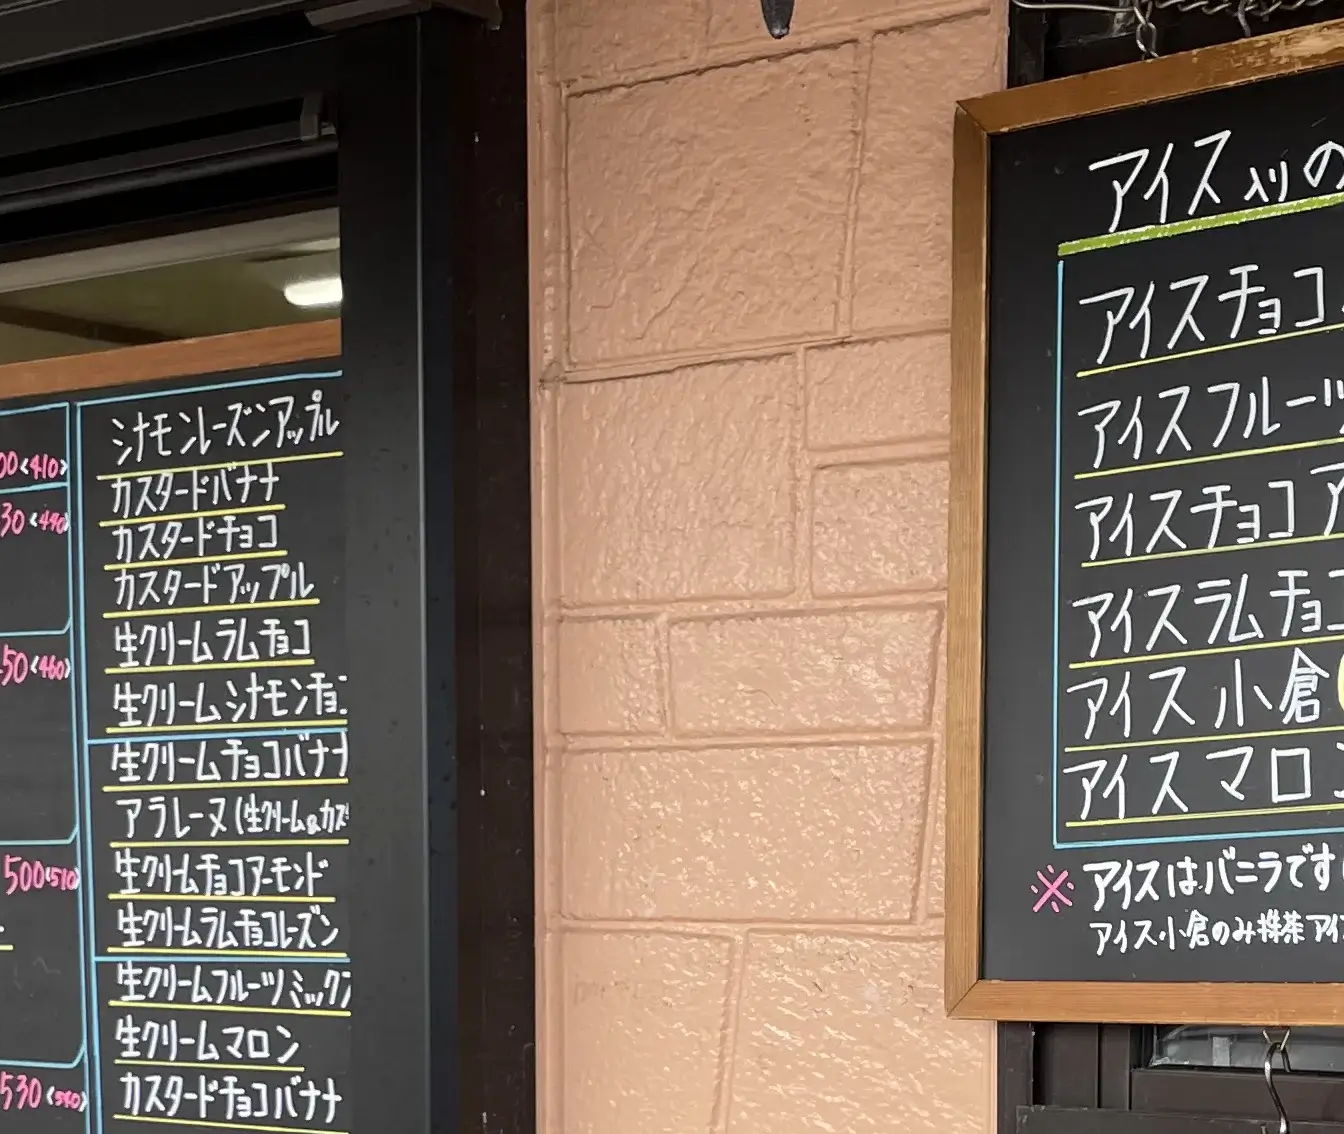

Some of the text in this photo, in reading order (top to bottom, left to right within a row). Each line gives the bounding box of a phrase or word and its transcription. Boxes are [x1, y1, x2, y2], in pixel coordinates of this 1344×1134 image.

[112, 390, 339, 466] シナモンレーズンアップル
[112, 462, 279, 519] カスタードバナナ
[113, 515, 276, 563] カスタードチョコ
[115, 562, 314, 610] カスタードアップル
[115, 618, 310, 668] 生クリームラムチョコ
[114, 672, 347, 726] 生クリームシナモンチョ
[115, 848, 328, 897] 生クリームチョコアーモンド
[118, 902, 338, 949] 生クリームラムチョコレーズン
[116, 1015, 299, 1063] 生クリームマロン
[120, 1072, 342, 1120] カスタードチョコバナナ
